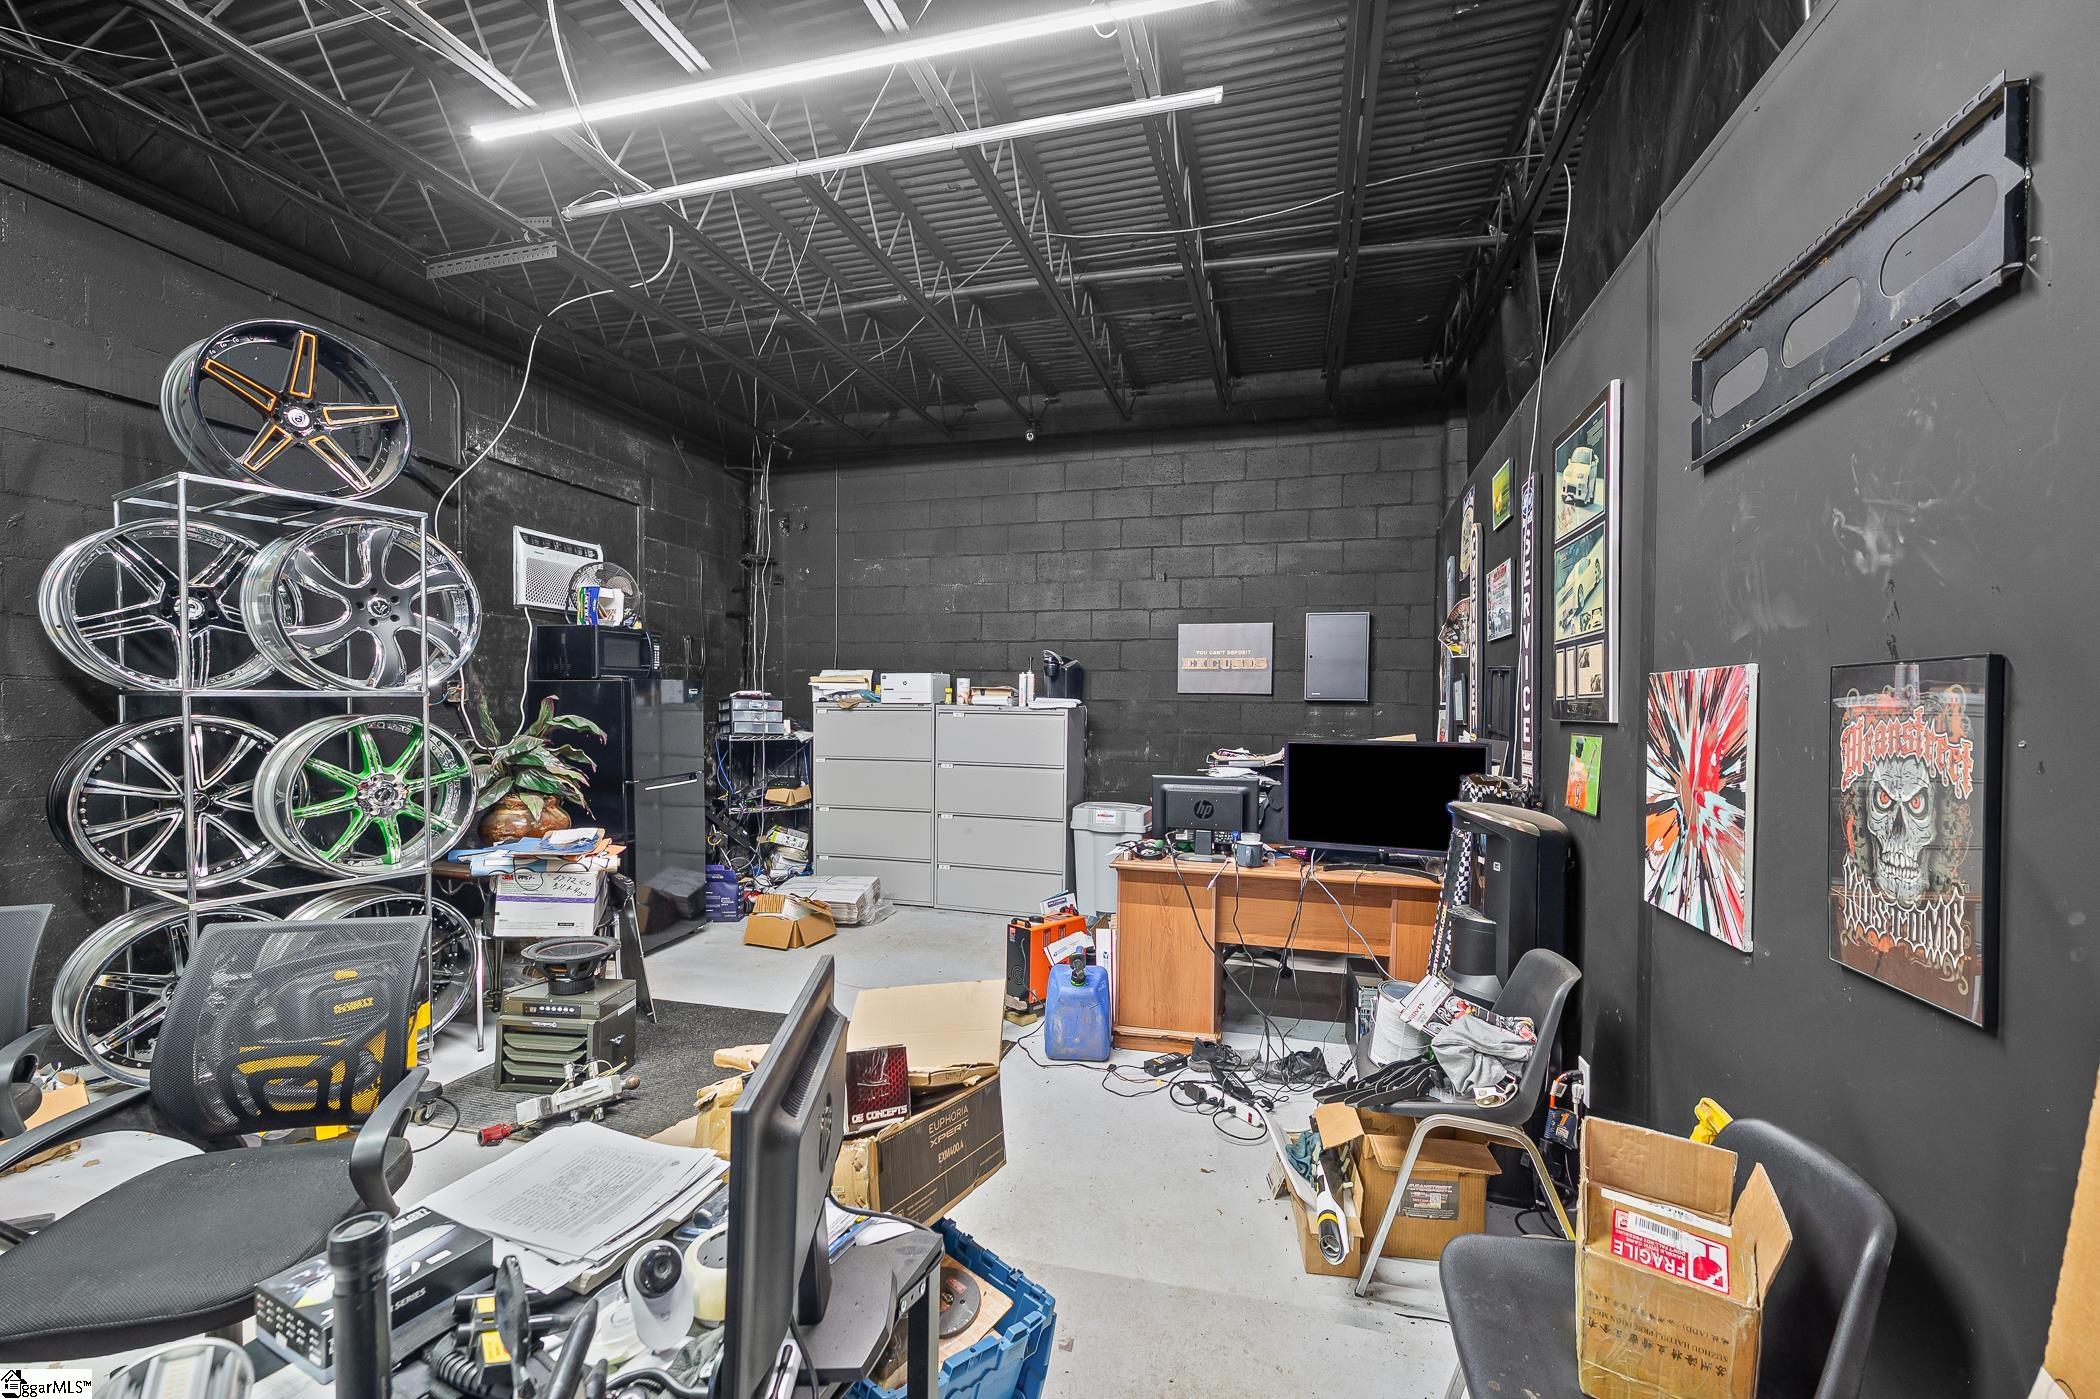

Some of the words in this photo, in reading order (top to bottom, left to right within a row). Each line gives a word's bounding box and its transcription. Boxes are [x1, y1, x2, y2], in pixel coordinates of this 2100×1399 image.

[1195, 800, 1213, 819] hp
[866, 1104, 908, 1122] CONCEPTS
[928, 1105, 969, 1135] EUPHORIA
[930, 1119, 969, 1149] XPERT
[1613, 1239, 1687, 1279] FRAGILE
[394, 1286, 427, 1311] SERIES
[1693, 1345, 1728, 1363] SUZHOU
